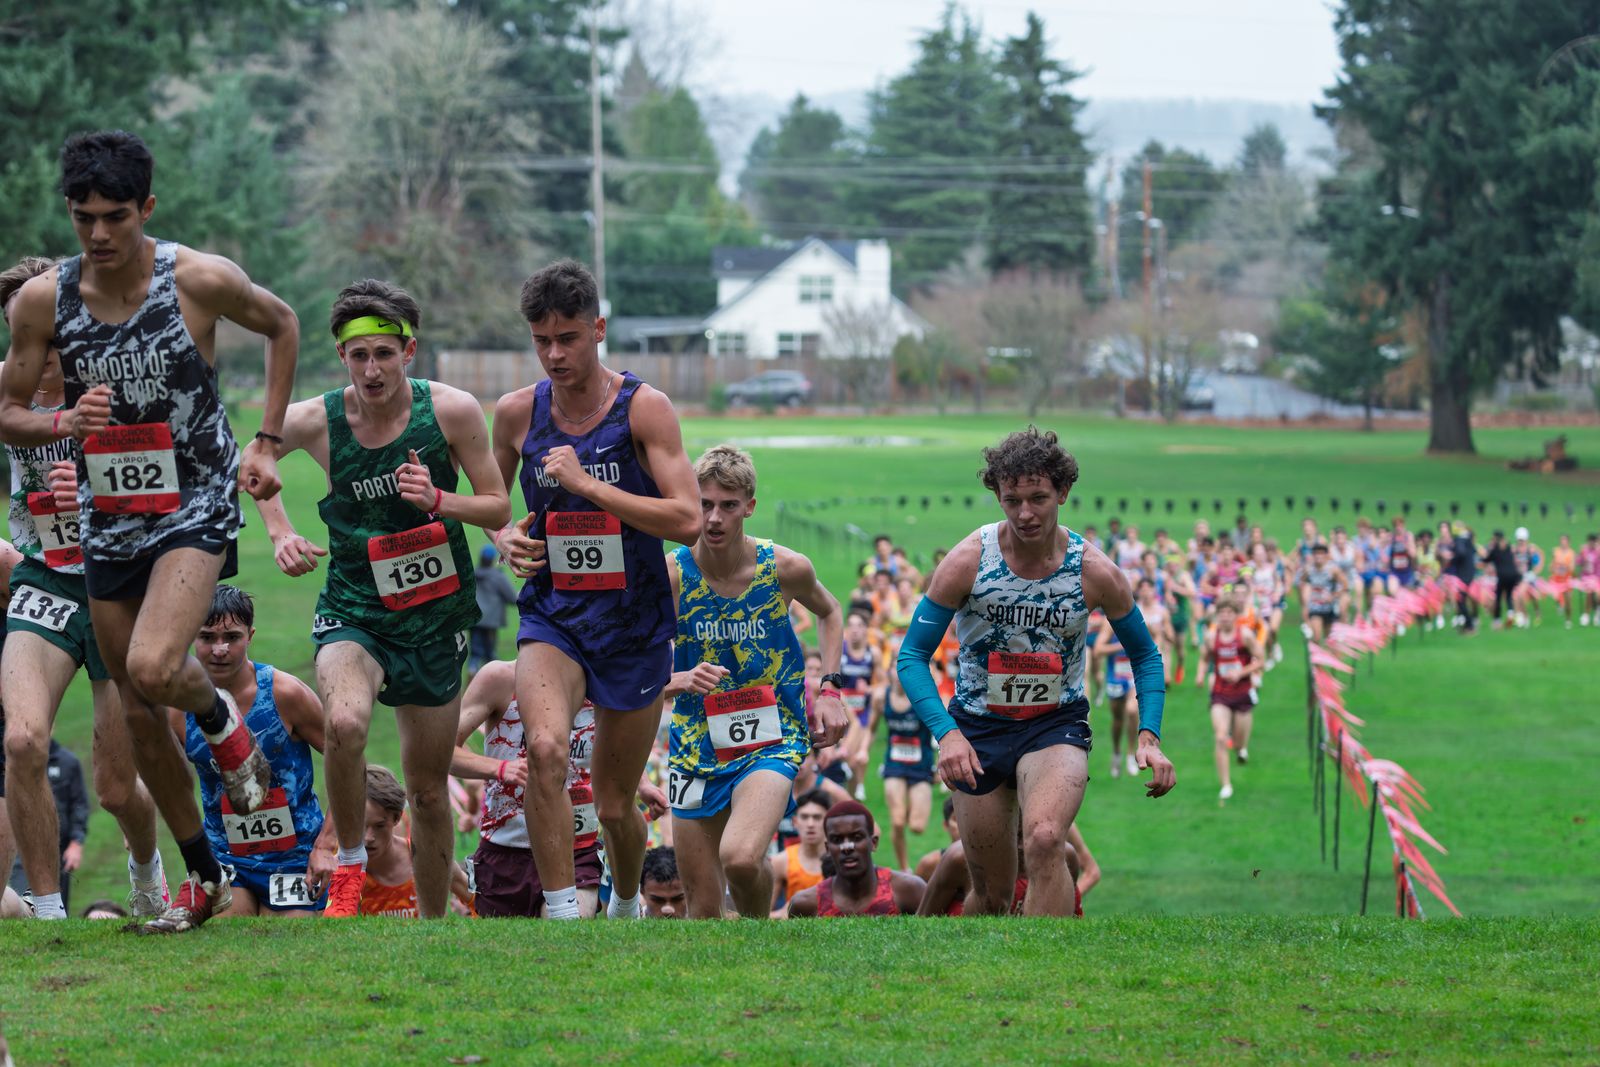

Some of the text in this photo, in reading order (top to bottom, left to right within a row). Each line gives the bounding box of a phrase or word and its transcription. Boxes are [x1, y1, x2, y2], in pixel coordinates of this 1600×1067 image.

[75, 349, 171, 382] GARDEN OF
[123, 376, 169, 405] GODS
[111, 456, 149, 465] CAMPOS
[103, 463, 164, 492] 182
[351, 472, 400, 501] PORTL
[557, 522, 607, 530] NATIONALS
[576, 514, 607, 522] CROSS
[51, 521, 80, 545] 13
[400, 528, 432, 542] CROSS
[381, 535, 432, 553] NATIONALS
[392, 552, 431, 567] WILLIAMS
[566, 547, 602, 570] 99
[389, 556, 442, 589] 130
[12, 590, 72, 627] 134
[986, 604, 1070, 628] SOUTHEAST
[695, 618, 766, 642] COLUMBUS
[1002, 662, 1049, 670] NATIONALS
[1022, 655, 1050, 663] CROSS
[715, 689, 763, 703] NIKE CROSS
[717, 696, 762, 709] NATIONALS
[1001, 683, 1049, 703] 172
[730, 713, 756, 722] WORKS
[729, 718, 760, 743] 67
[669, 772, 694, 806] 67
[244, 813, 268, 821] GLENN
[236, 818, 283, 840] 146
